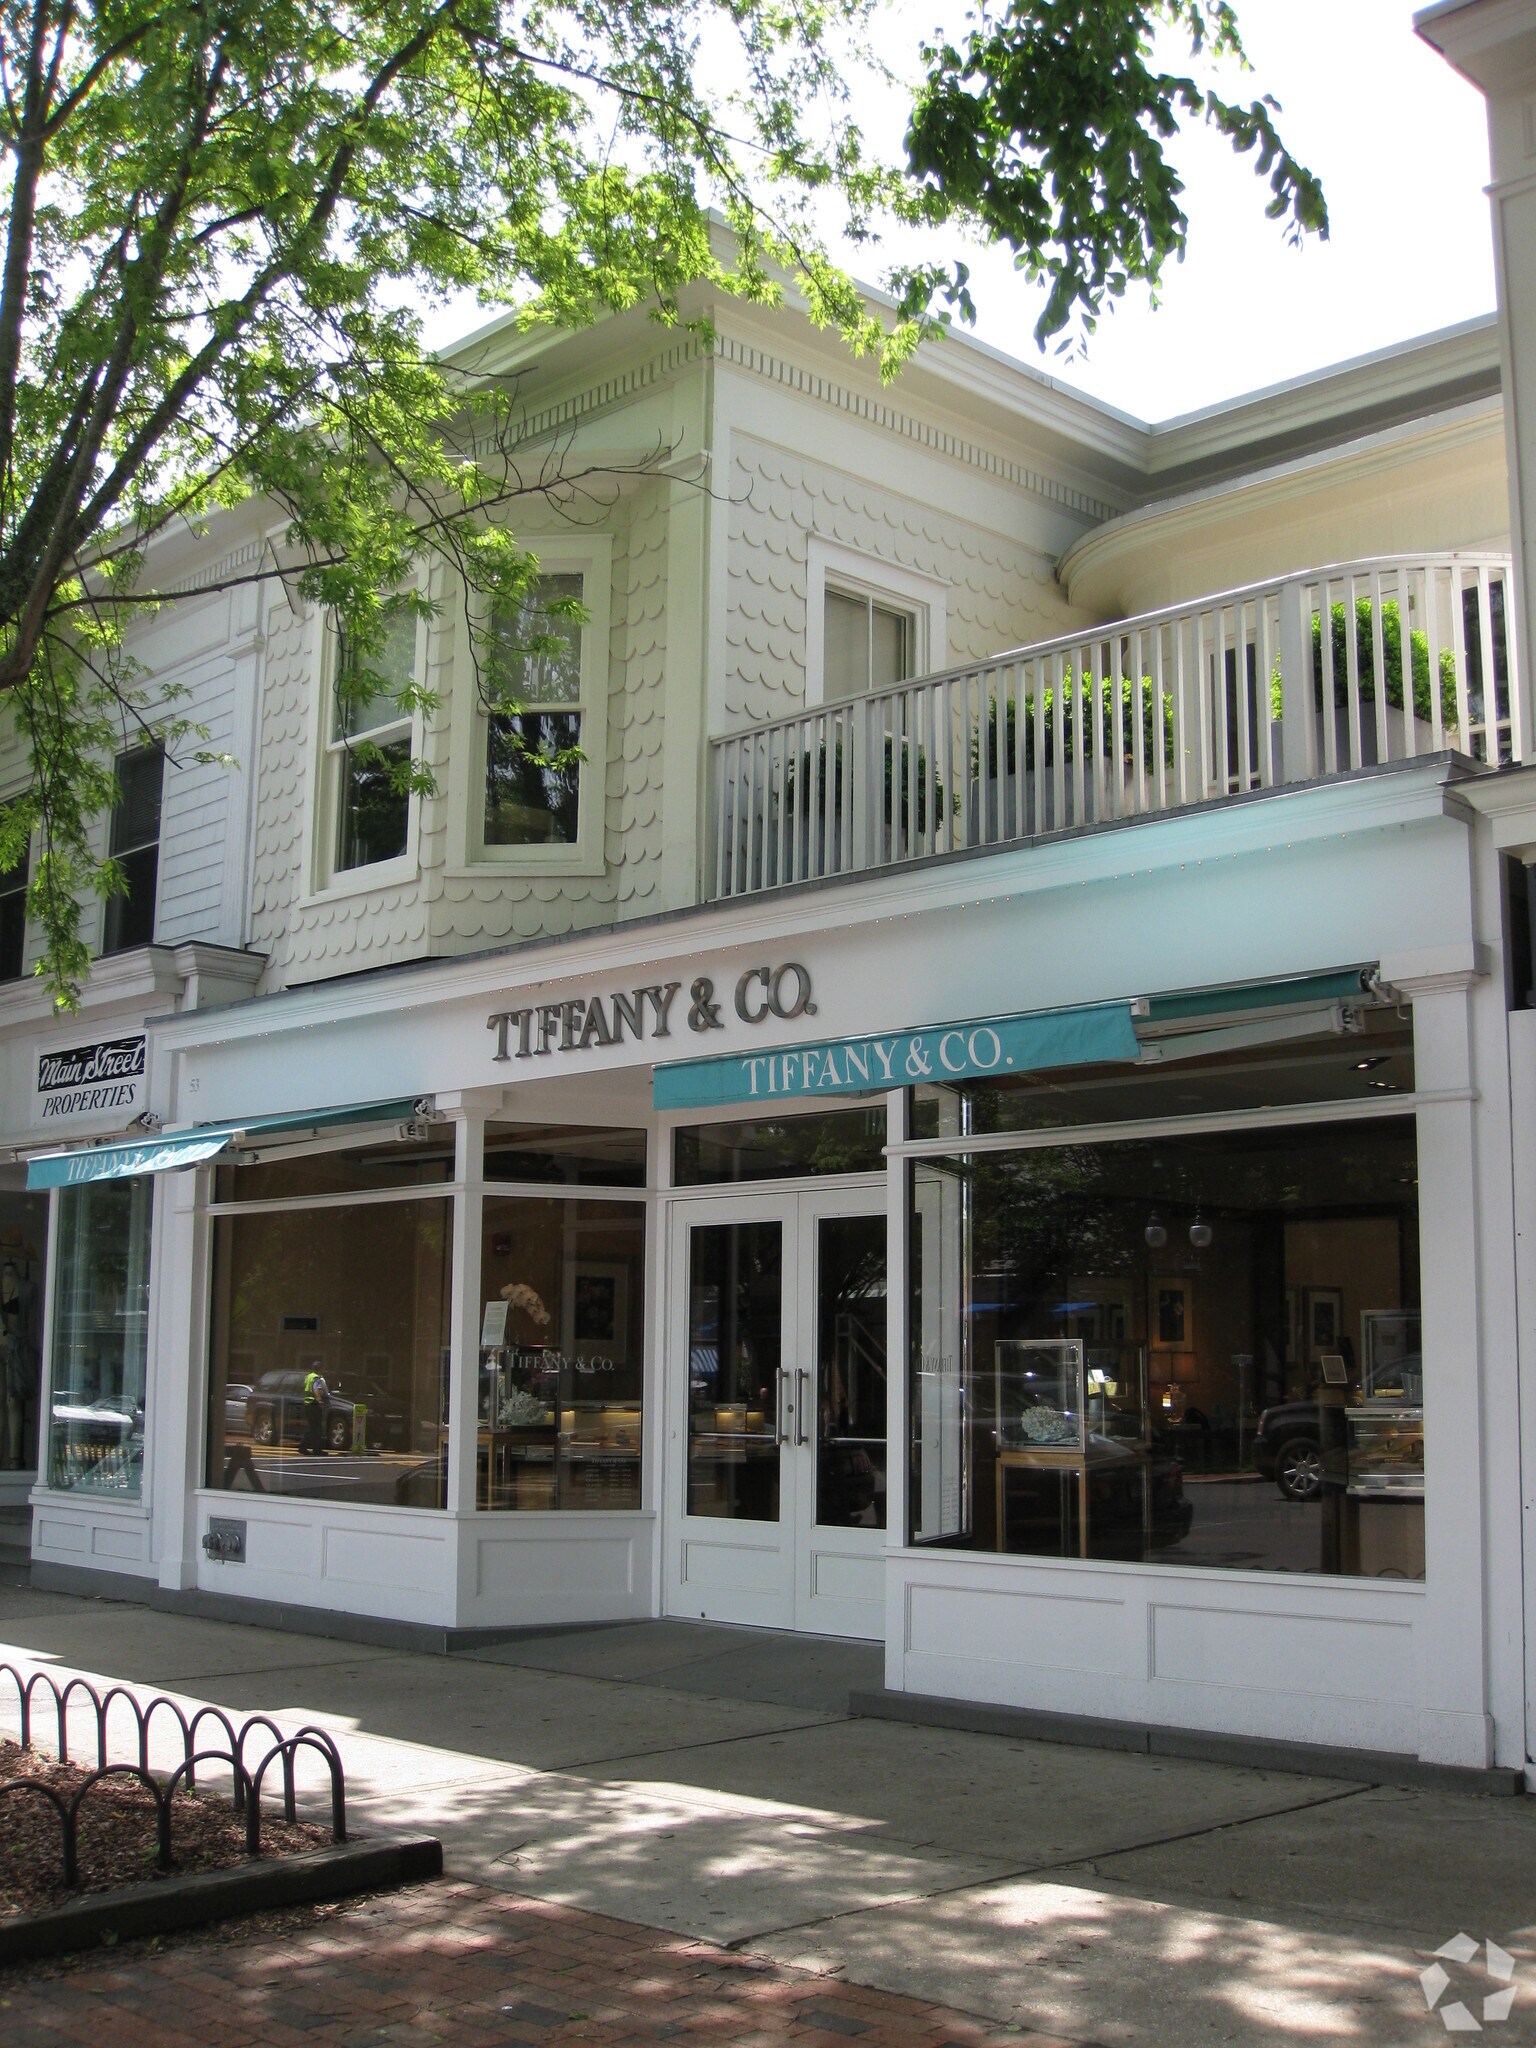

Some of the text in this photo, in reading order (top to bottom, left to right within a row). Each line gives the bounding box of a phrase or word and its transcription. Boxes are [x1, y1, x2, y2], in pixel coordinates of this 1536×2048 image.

[486, 962, 818, 1061] TIFFANY & CO.
[39, 1040, 147, 1089] Main Street
[741, 1027, 1014, 1095] TIFFANY & CO.
[42, 1083, 137, 1118] PROPERTIES
[67, 1148, 134, 1182] TIFFANY
[508, 1350, 572, 1370] TIFFANY
